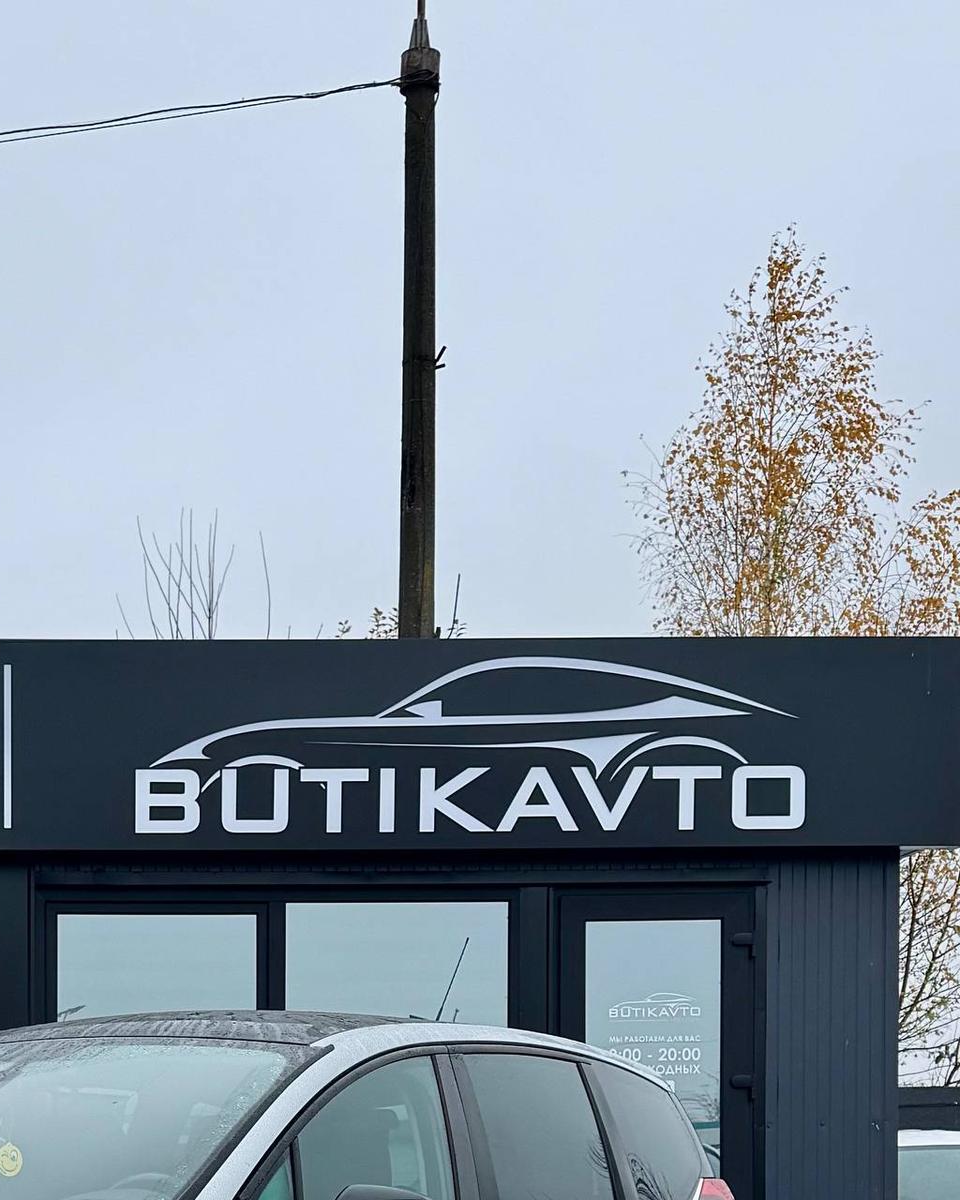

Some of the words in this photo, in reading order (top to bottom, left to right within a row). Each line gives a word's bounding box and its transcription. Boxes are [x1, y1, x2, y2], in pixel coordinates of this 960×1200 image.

[135, 765, 807, 834] BUTIKAVTO
[609, 1006, 701, 1018] BUTIKAVTO
[684, 1034, 701, 1042] ВАС
[658, 1047, 701, 1061] 20:00
